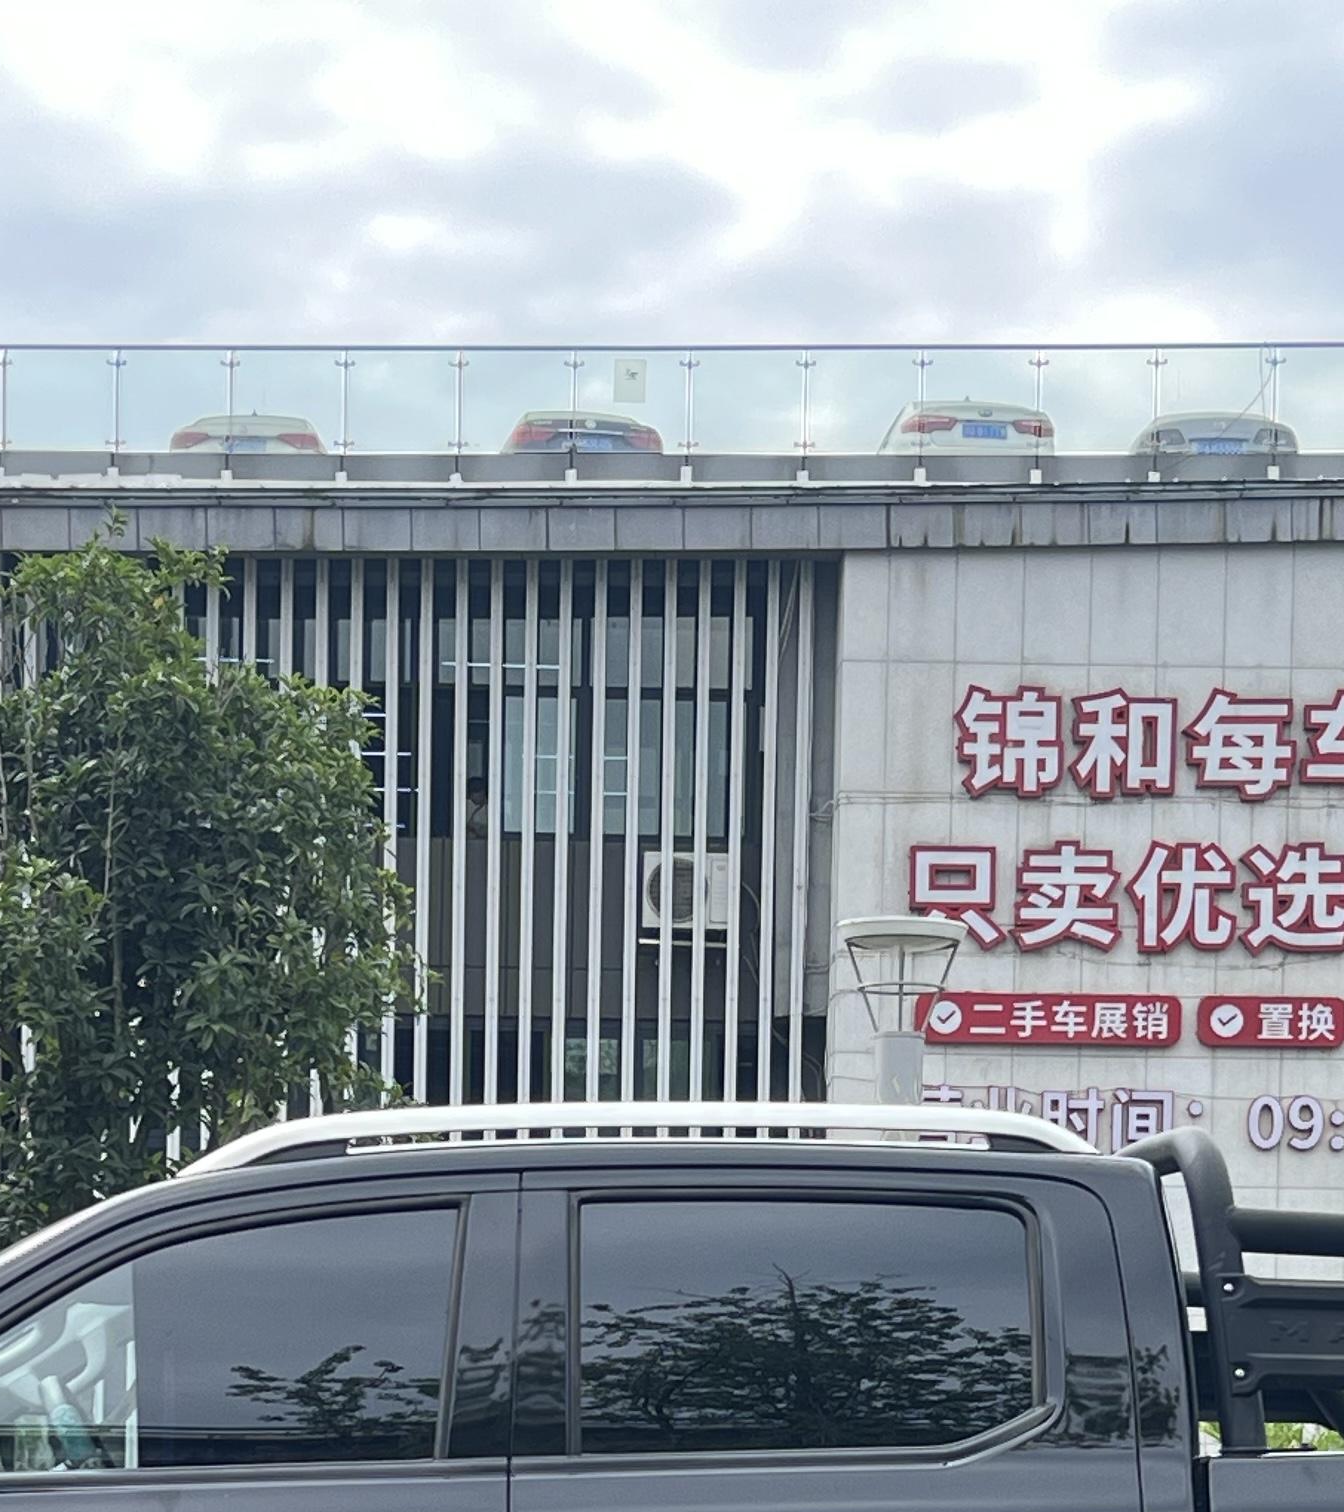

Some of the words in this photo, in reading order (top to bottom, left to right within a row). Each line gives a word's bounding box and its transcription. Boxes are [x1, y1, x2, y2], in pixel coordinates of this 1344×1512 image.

[969, 1001, 1168, 1040] 二手车展销
[1257, 1003, 1336, 1041] 置换
